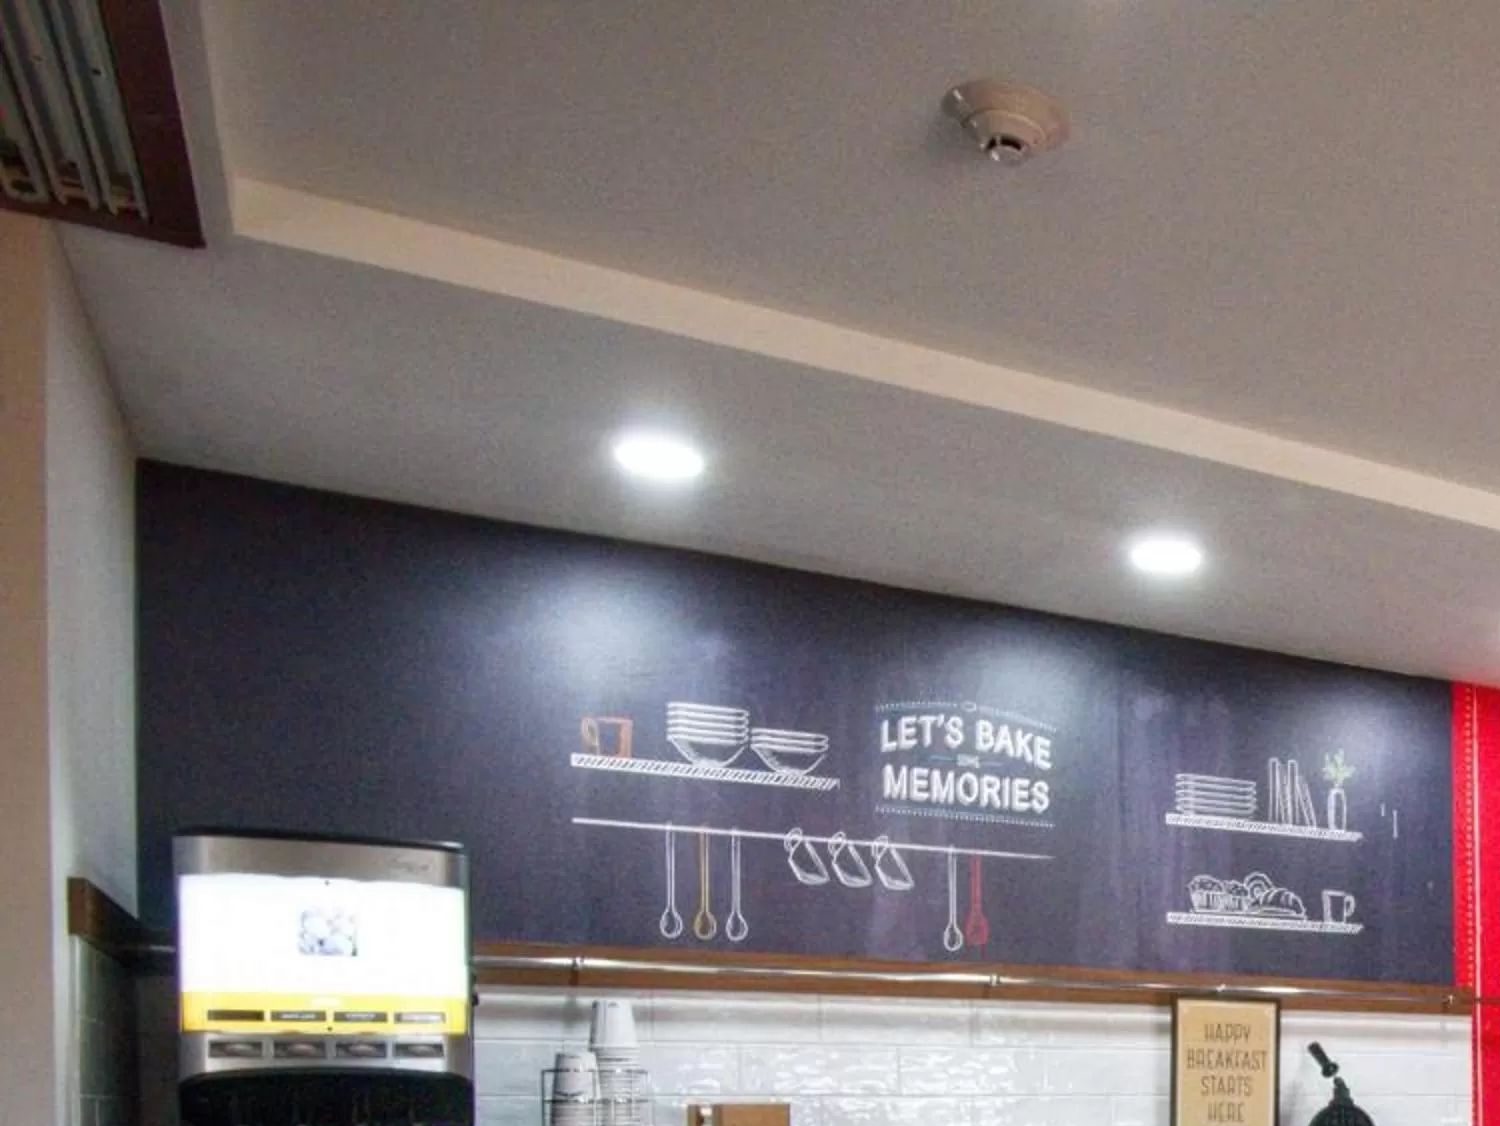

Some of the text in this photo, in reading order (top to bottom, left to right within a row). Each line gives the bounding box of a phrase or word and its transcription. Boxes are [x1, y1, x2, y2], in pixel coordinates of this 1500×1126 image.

[881, 713, 1052, 771] LET'S BAKE
[883, 763, 1050, 814] MEMORIES
[1203, 1023, 1251, 1043] HAPPY
[1186, 1048, 1268, 1072] BREAKFAST
[1200, 1075, 1253, 1097] STARTS
[1207, 1102, 1245, 1122] HERE
